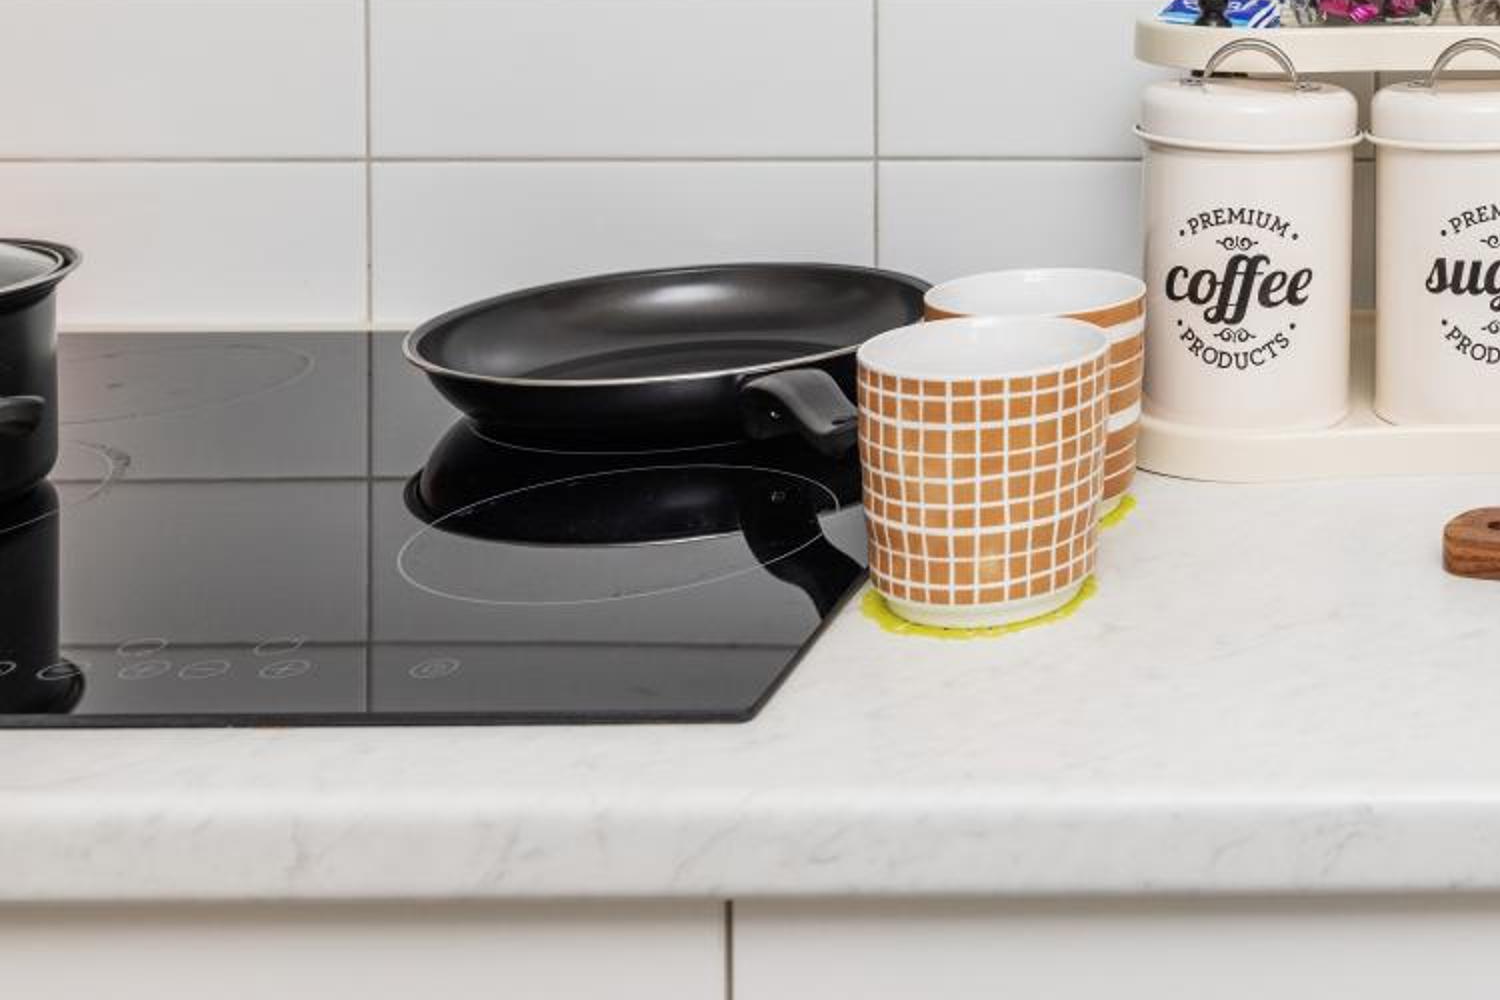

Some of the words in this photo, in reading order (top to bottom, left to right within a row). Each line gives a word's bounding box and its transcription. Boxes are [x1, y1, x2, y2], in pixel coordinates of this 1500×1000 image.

[1187, 207, 1290, 238] PREMIUM
[1166, 254, 1313, 325] coffee
[1179, 327, 1290, 370] PRODUCTS
